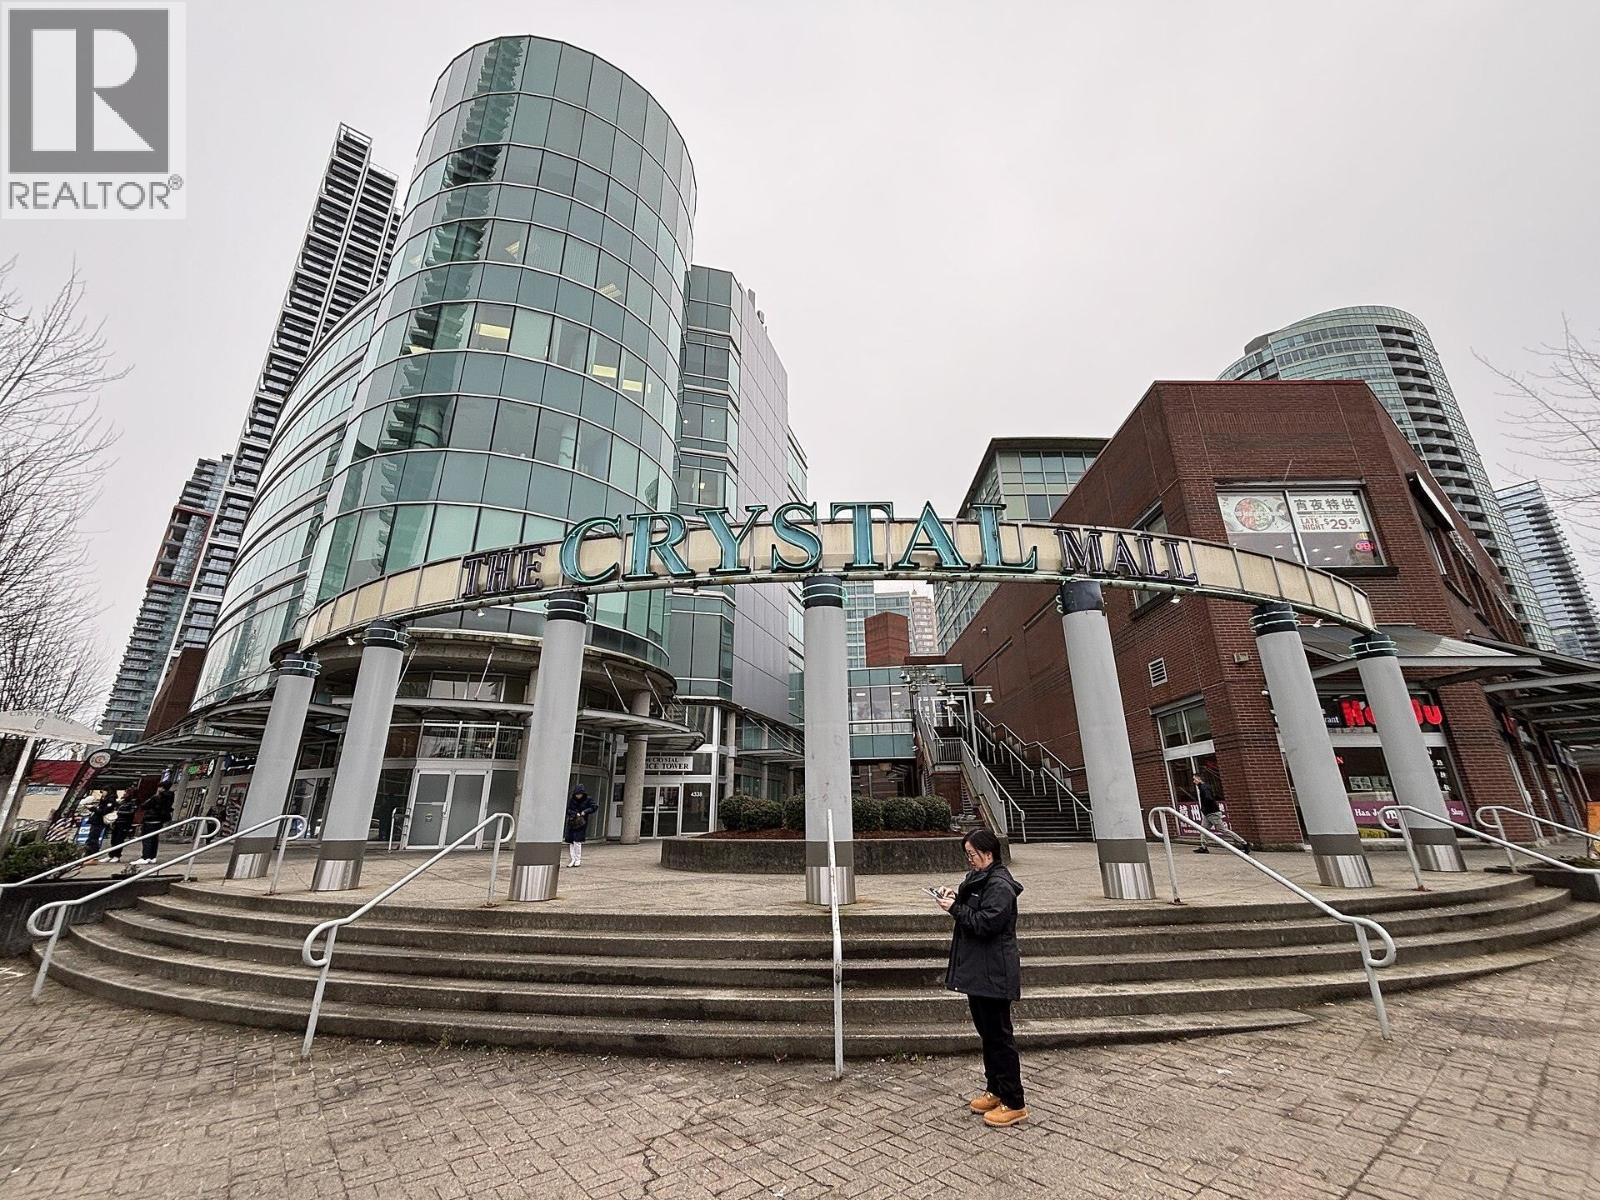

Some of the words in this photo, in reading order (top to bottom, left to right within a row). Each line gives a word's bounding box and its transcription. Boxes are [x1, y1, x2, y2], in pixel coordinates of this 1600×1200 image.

[1300, 517, 1319, 525] LATE
[462, 546, 546, 599] THE
[559, 500, 1037, 585] CRYSTAL
[1055, 526, 1199, 586] MALL
